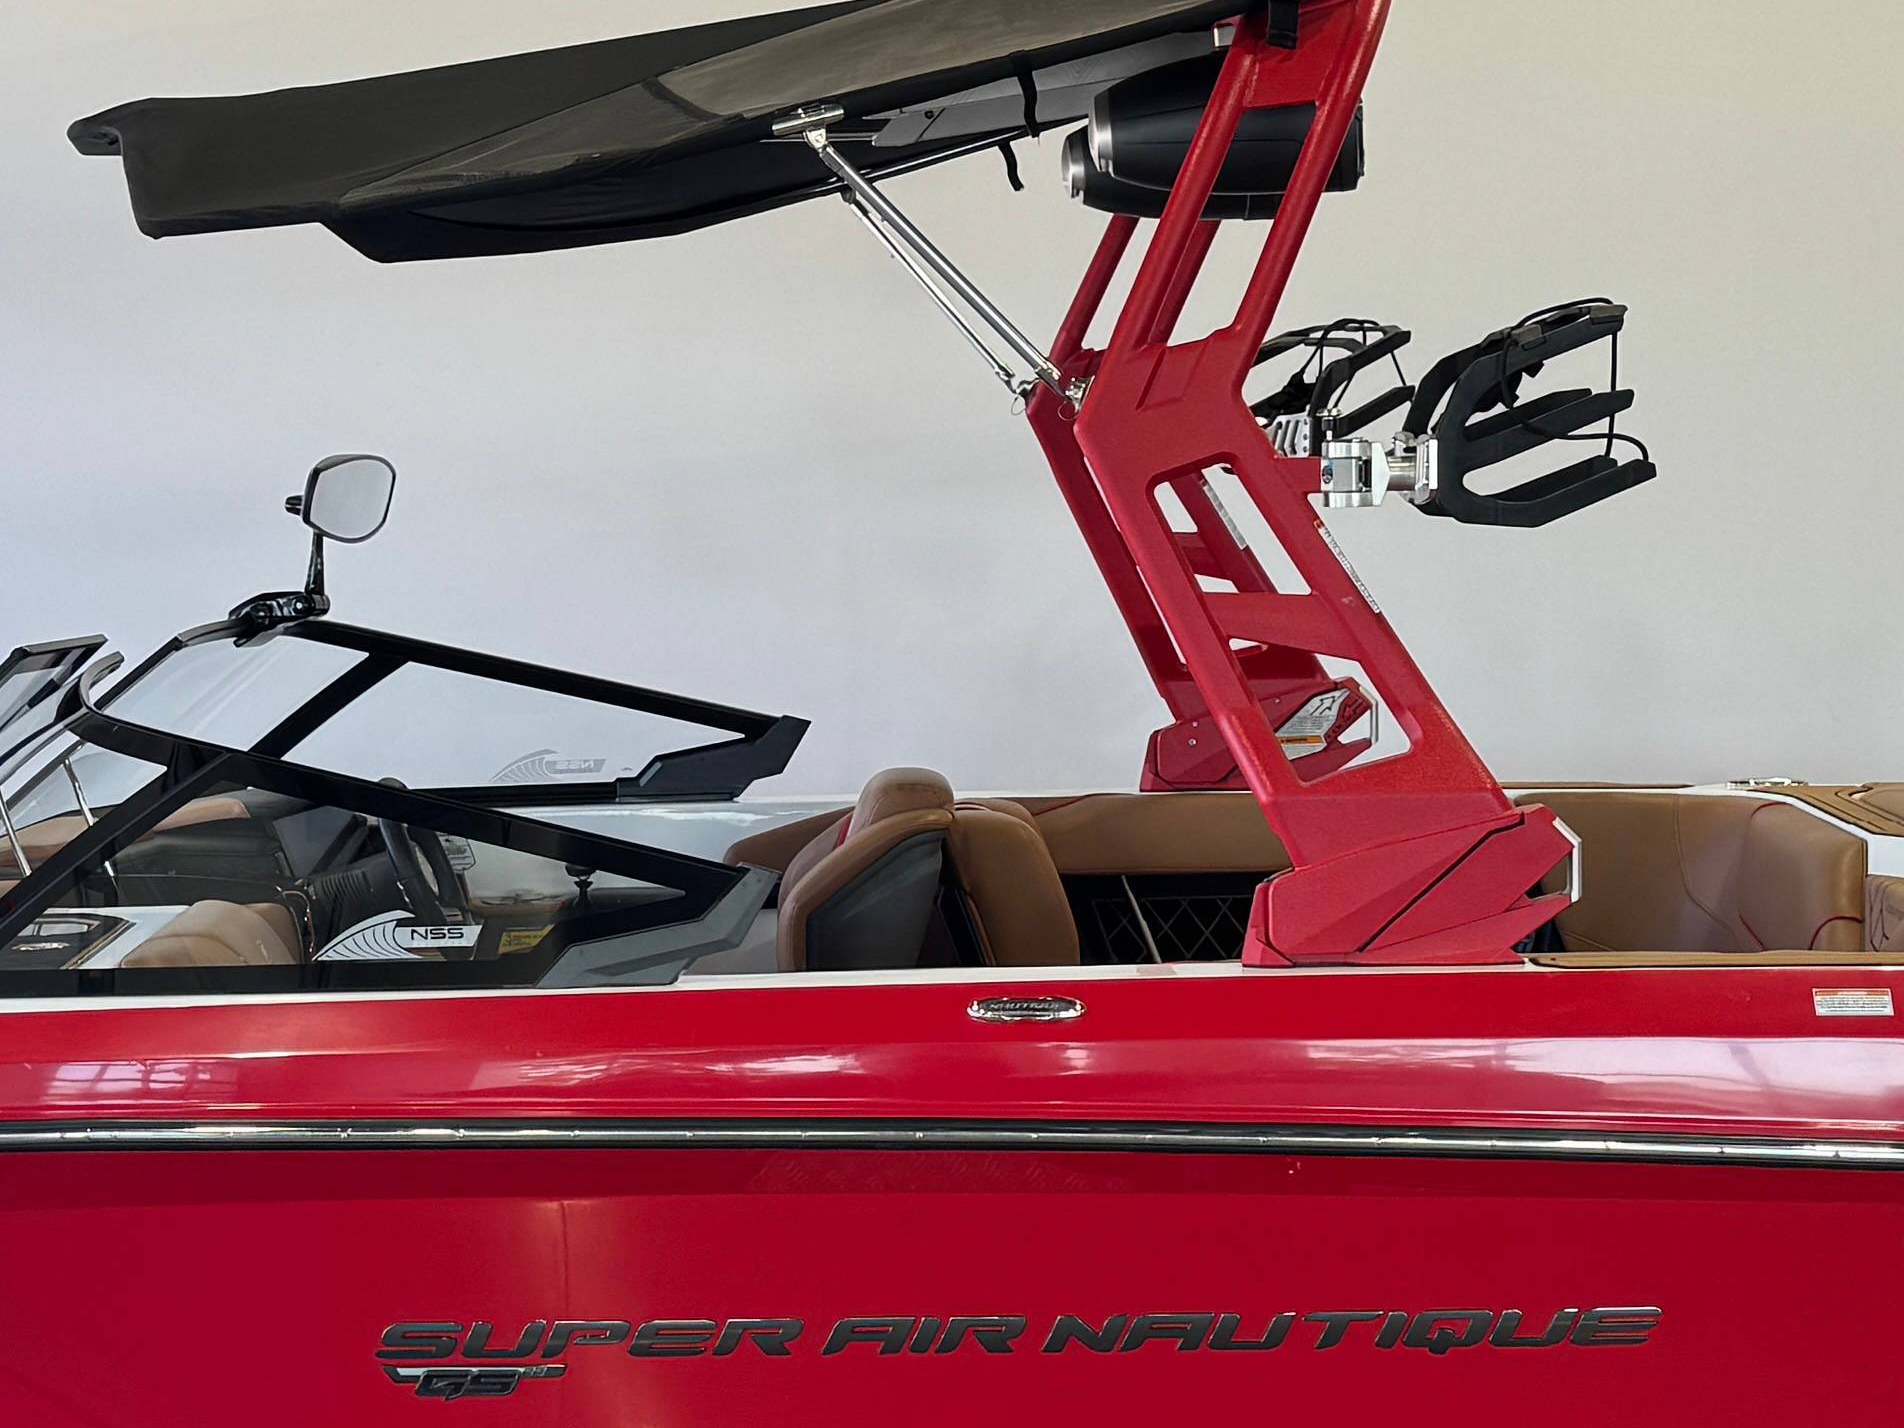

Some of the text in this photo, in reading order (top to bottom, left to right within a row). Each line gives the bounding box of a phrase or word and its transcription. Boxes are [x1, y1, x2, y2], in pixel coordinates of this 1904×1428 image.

[410, 927, 465, 941] NSS
[374, 1305, 1662, 1360] SUPER AIR NAUTIQUE
